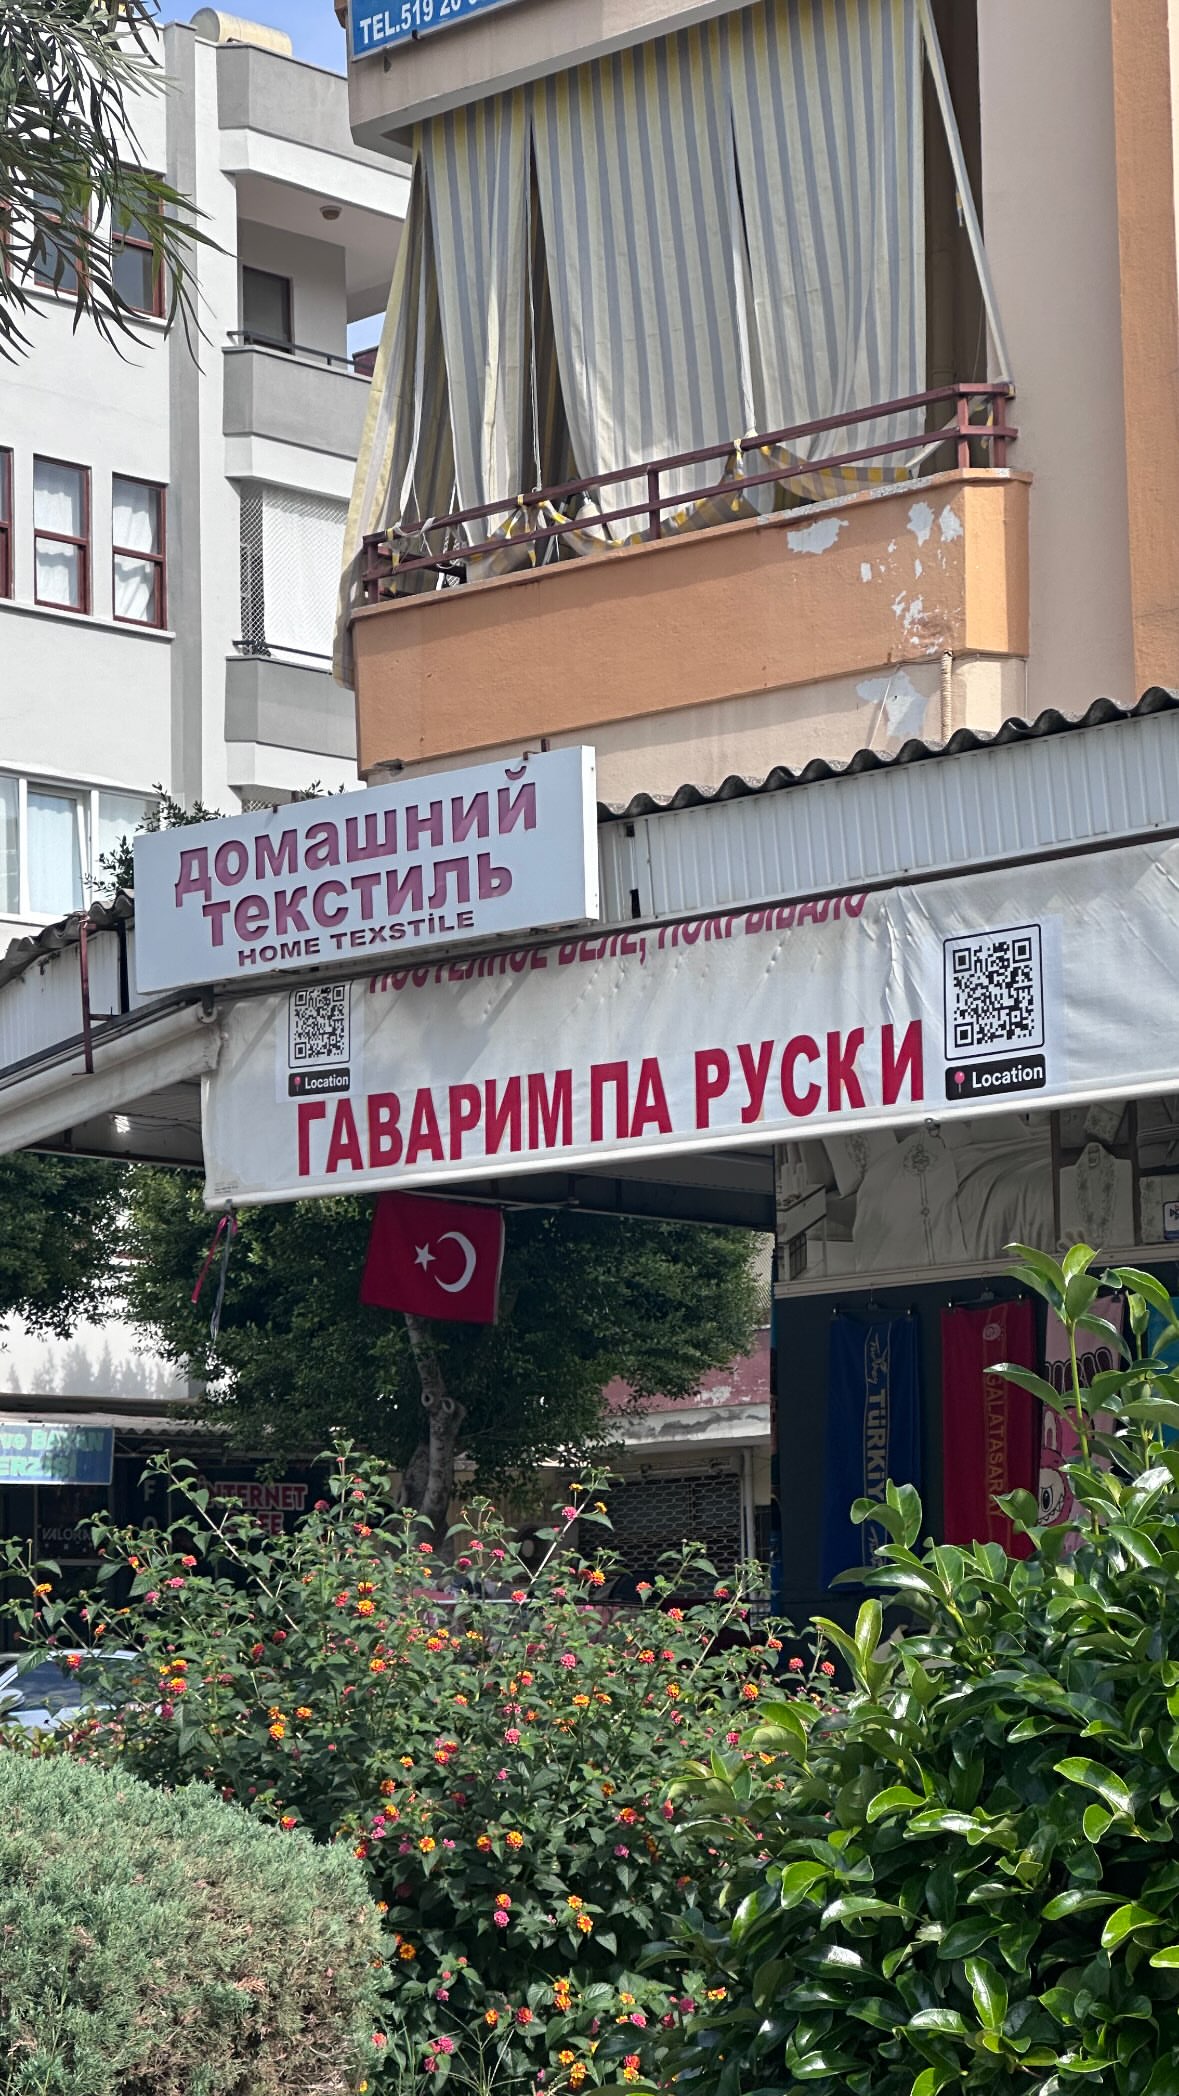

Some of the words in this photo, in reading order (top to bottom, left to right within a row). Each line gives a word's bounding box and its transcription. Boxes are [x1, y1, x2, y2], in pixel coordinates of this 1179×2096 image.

[202, 852, 513, 947] текстиль
[237, 936, 321, 967] HOME
[304, 1074, 349, 1089] Location
[971, 1064, 1044, 1089] Location
[297, 1069, 574, 1178] ГАВАРИМ
[590, 1056, 674, 1144] ПА
[694, 1020, 925, 1131] РУСКИ
